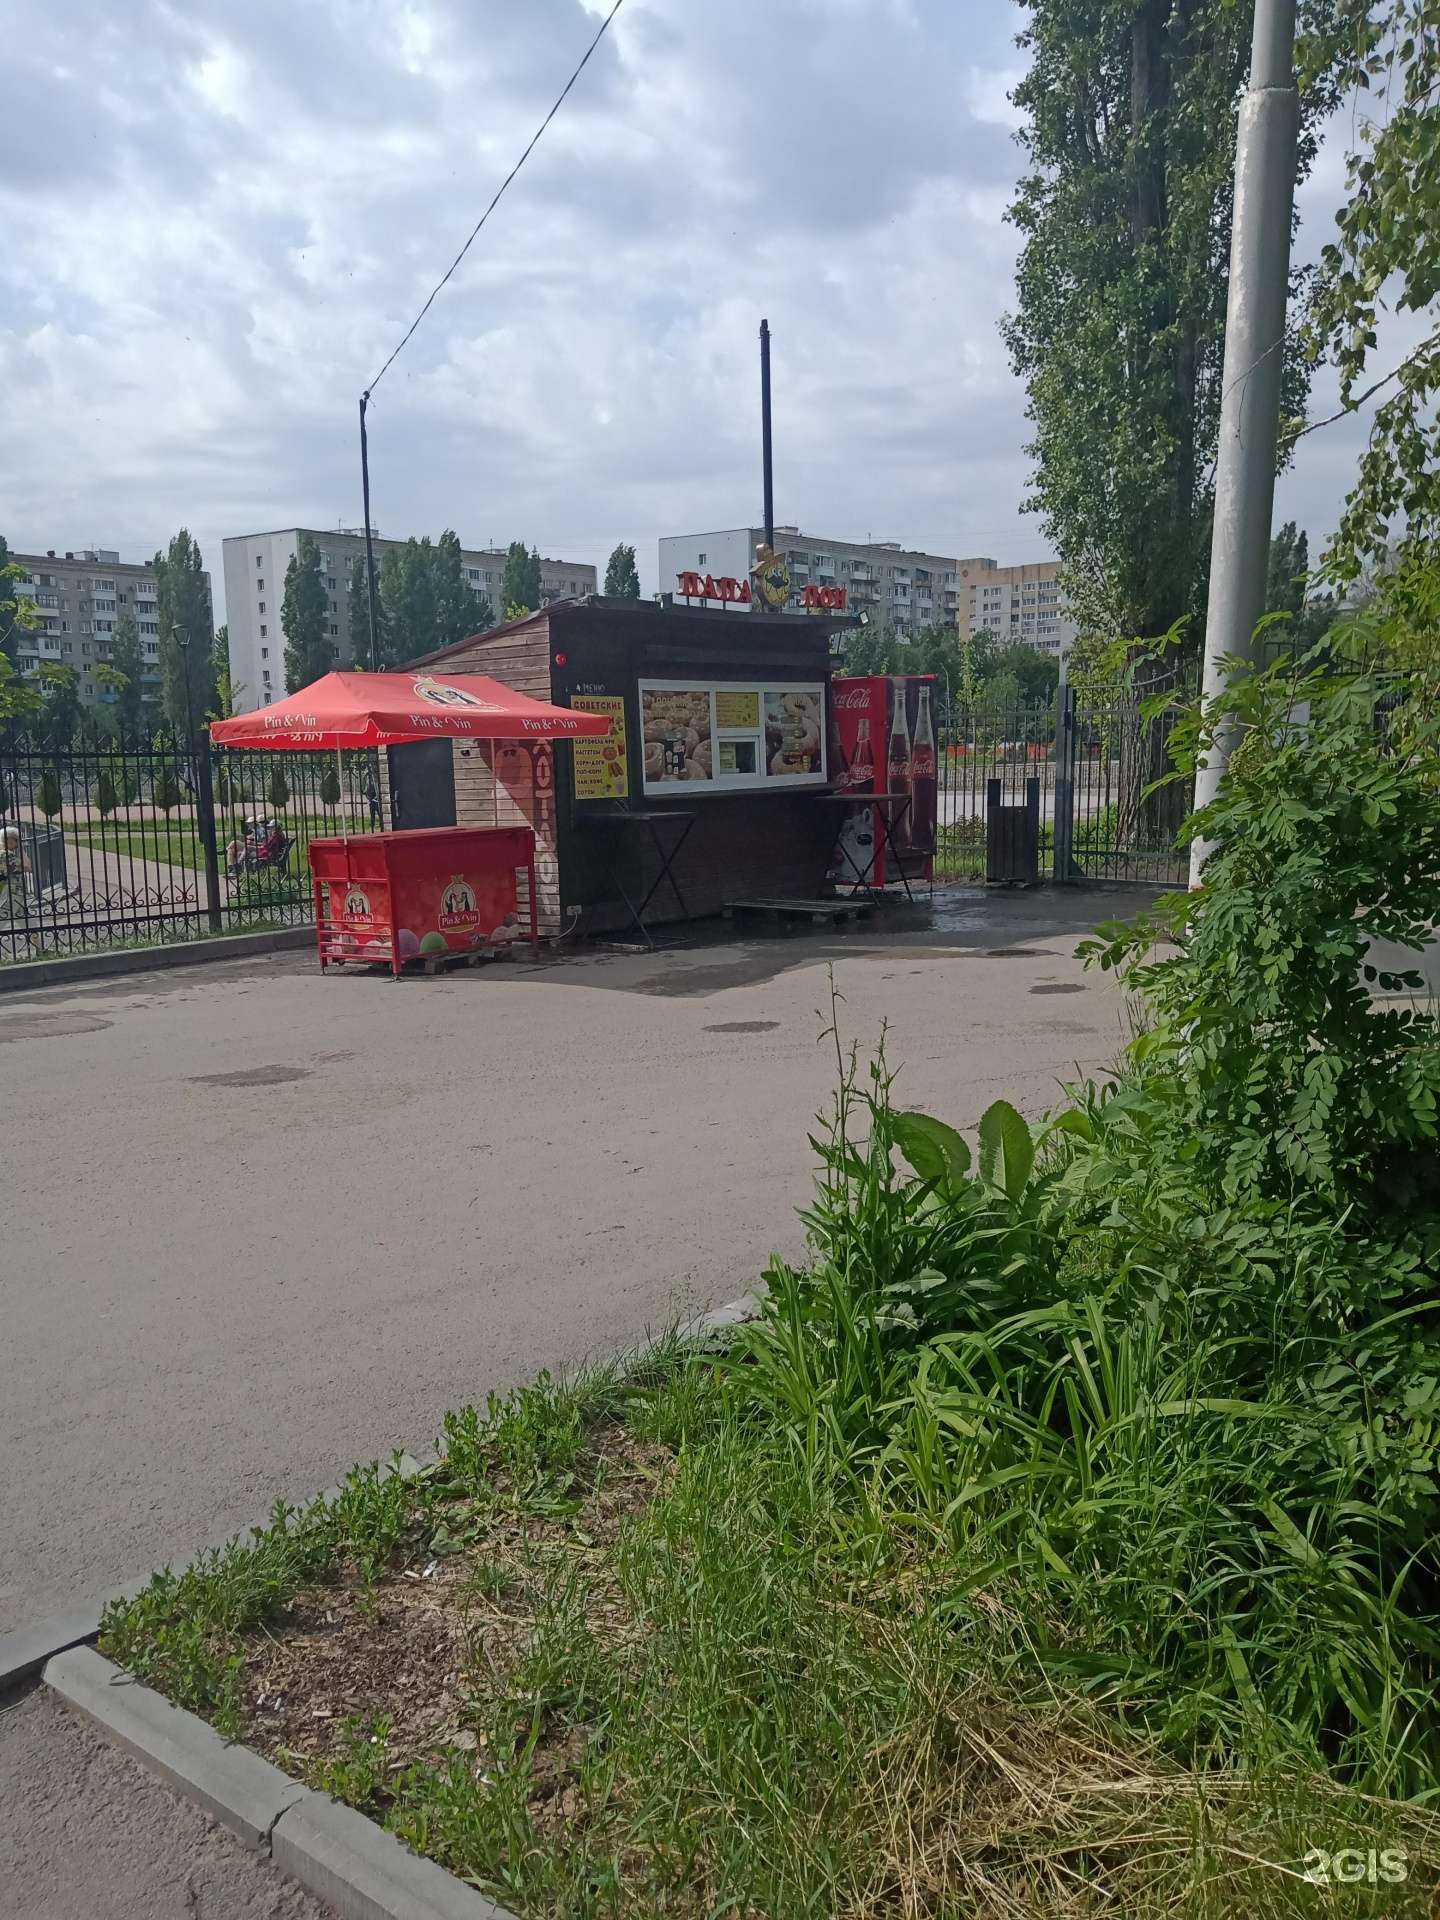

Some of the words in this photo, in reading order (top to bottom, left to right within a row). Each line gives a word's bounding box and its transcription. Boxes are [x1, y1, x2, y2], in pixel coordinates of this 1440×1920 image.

[676, 572, 752, 603] ПАПА
[801, 585, 847, 609] ПОН
[574, 702, 621, 710] СОВЕТСКИЕ
[264, 716, 281, 728] Pin
[284, 714, 294, 727] &
[295, 713, 316, 726] Vin
[409, 714, 431, 728] Pin
[432, 716, 444, 728] &
[445, 717, 472, 729] Vin
[521, 718, 541, 730] Pin
[542, 719, 552, 730] &
[553, 718, 578, 729] Vin
[442, 917, 454, 926] Pin
